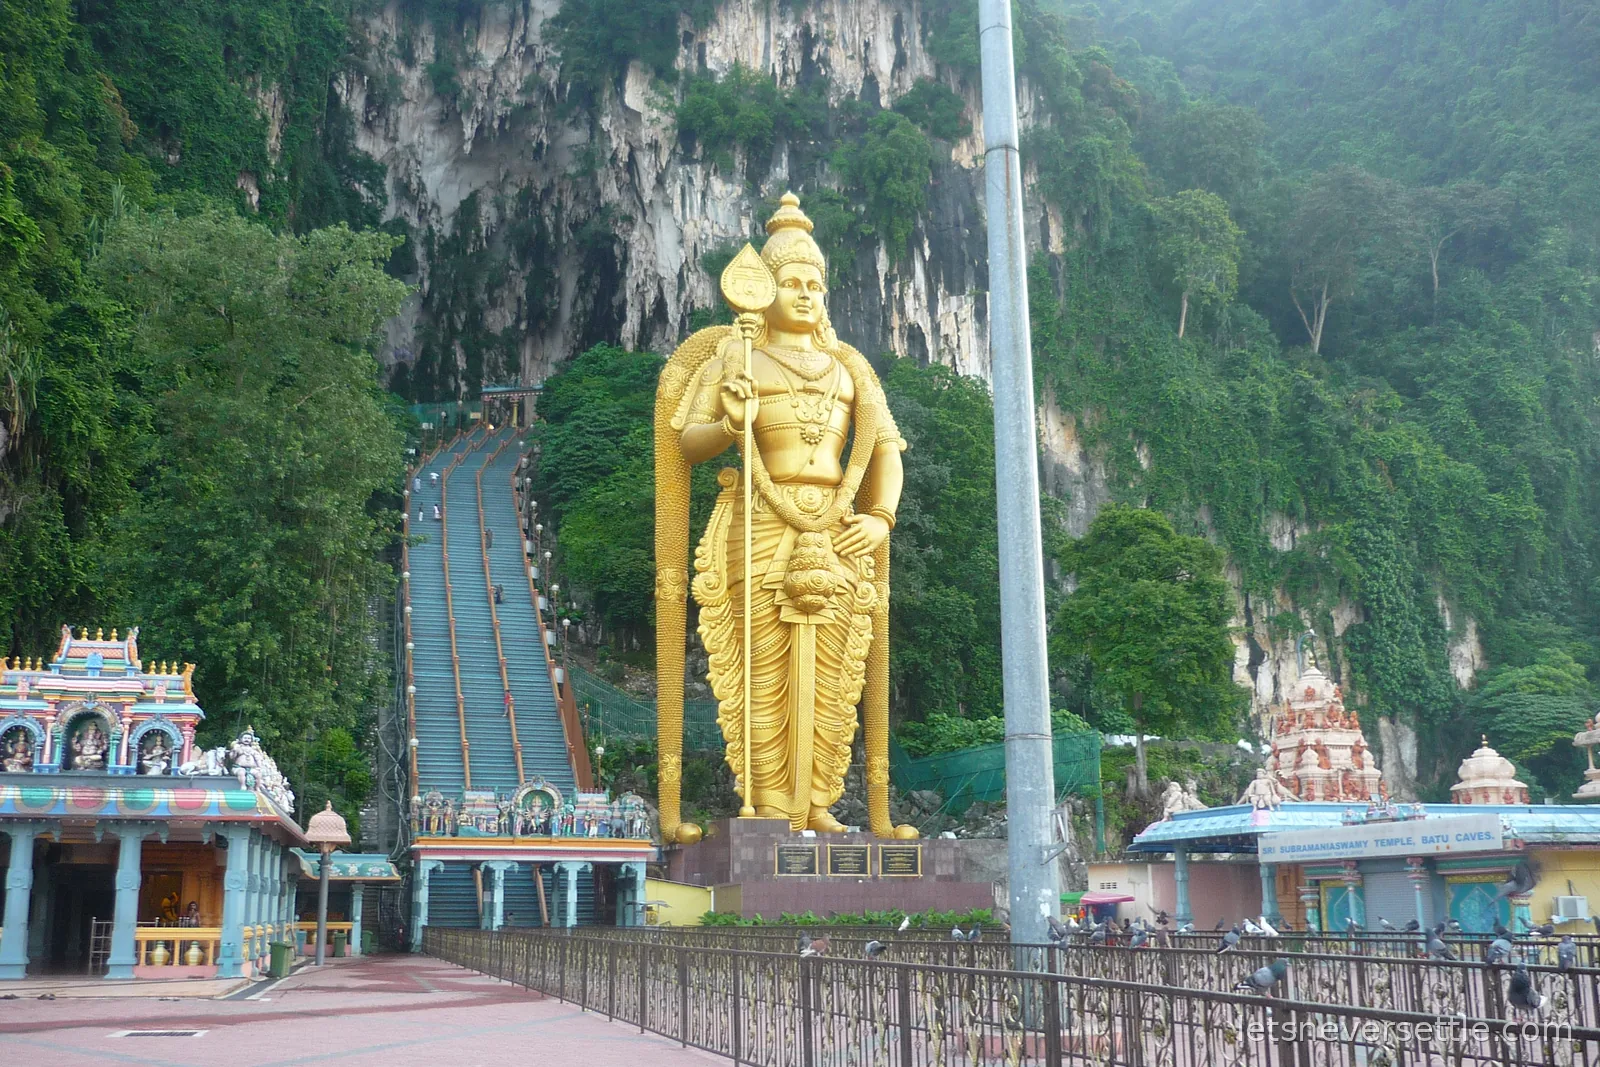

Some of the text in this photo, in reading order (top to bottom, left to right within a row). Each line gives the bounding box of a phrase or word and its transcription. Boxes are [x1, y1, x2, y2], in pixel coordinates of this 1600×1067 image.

[1262, 831, 1495, 855] SRI SUBRAMANIASWAMY TEMPLE, BATU CAVES.
